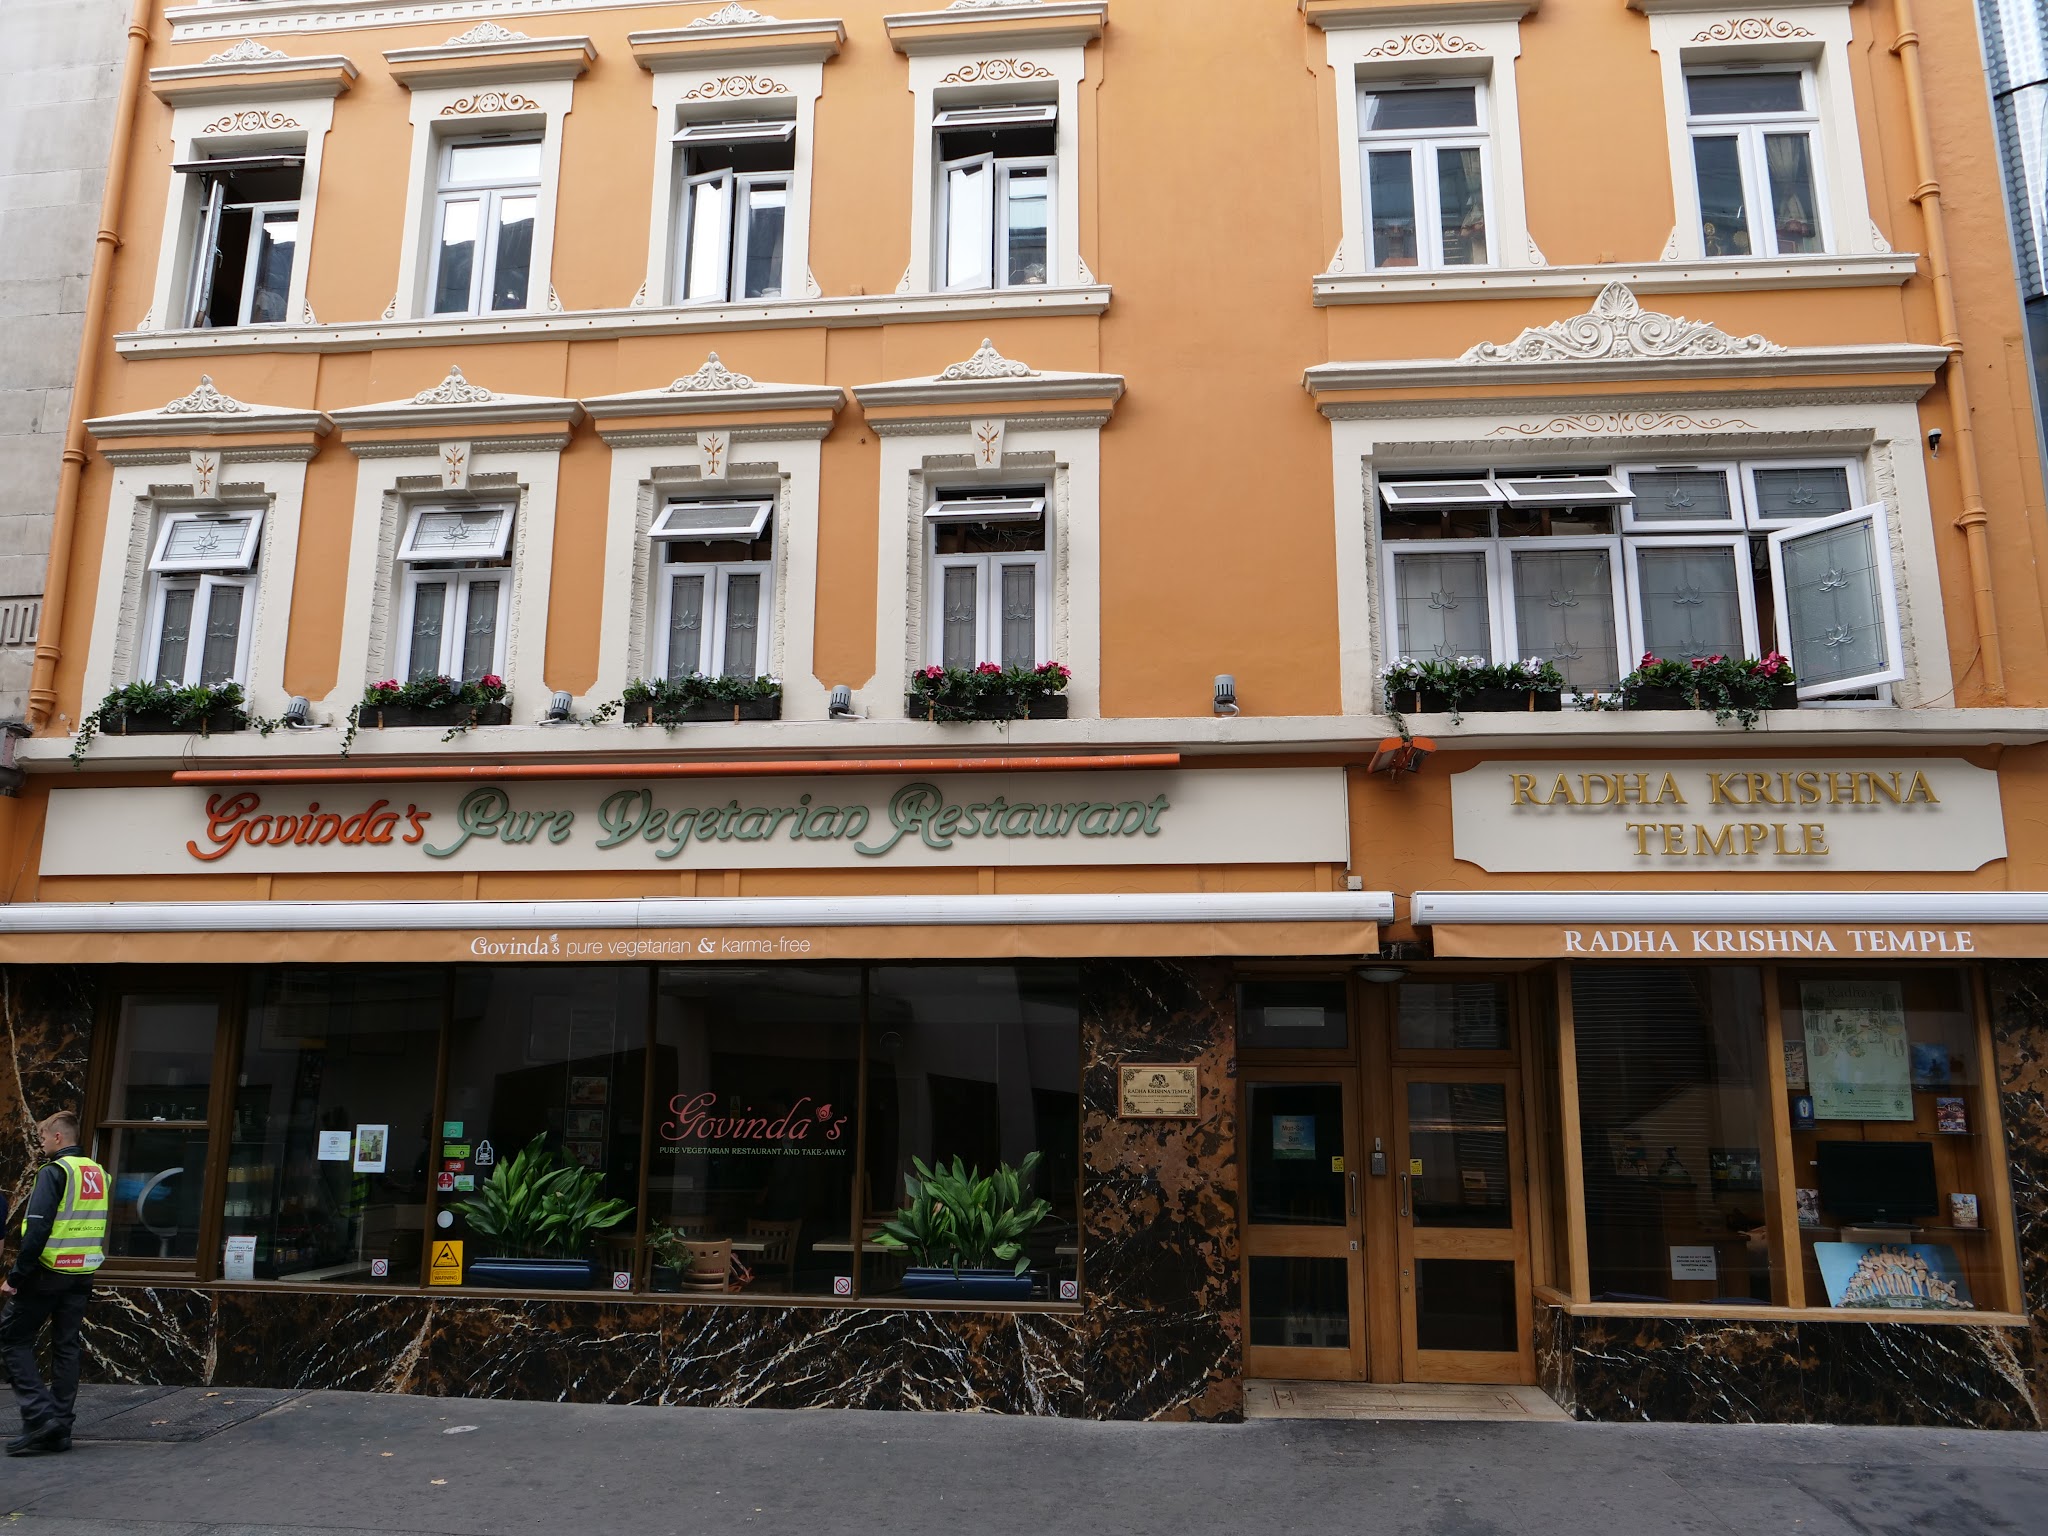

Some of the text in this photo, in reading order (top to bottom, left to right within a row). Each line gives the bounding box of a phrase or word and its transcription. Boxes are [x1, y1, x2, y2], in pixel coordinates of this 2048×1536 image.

[1509, 770, 1941, 805] RADHA KRISHNA
[187, 782, 1171, 861] Govinda's Pure Vegetarian Restaurant
[1626, 821, 1830, 856] TEMPLE
[470, 933, 811, 957] Govinda's pure vegetarian & karma-free
[1564, 930, 1976, 953] RADHA KRISHNA TEMPLE
[660, 1092, 848, 1141] Govinda's
[659, 1146, 847, 1157] PURE VEGETARIAN RESTAURANT AND TAKE-AWAY
[83, 1170, 101, 1194] SK
